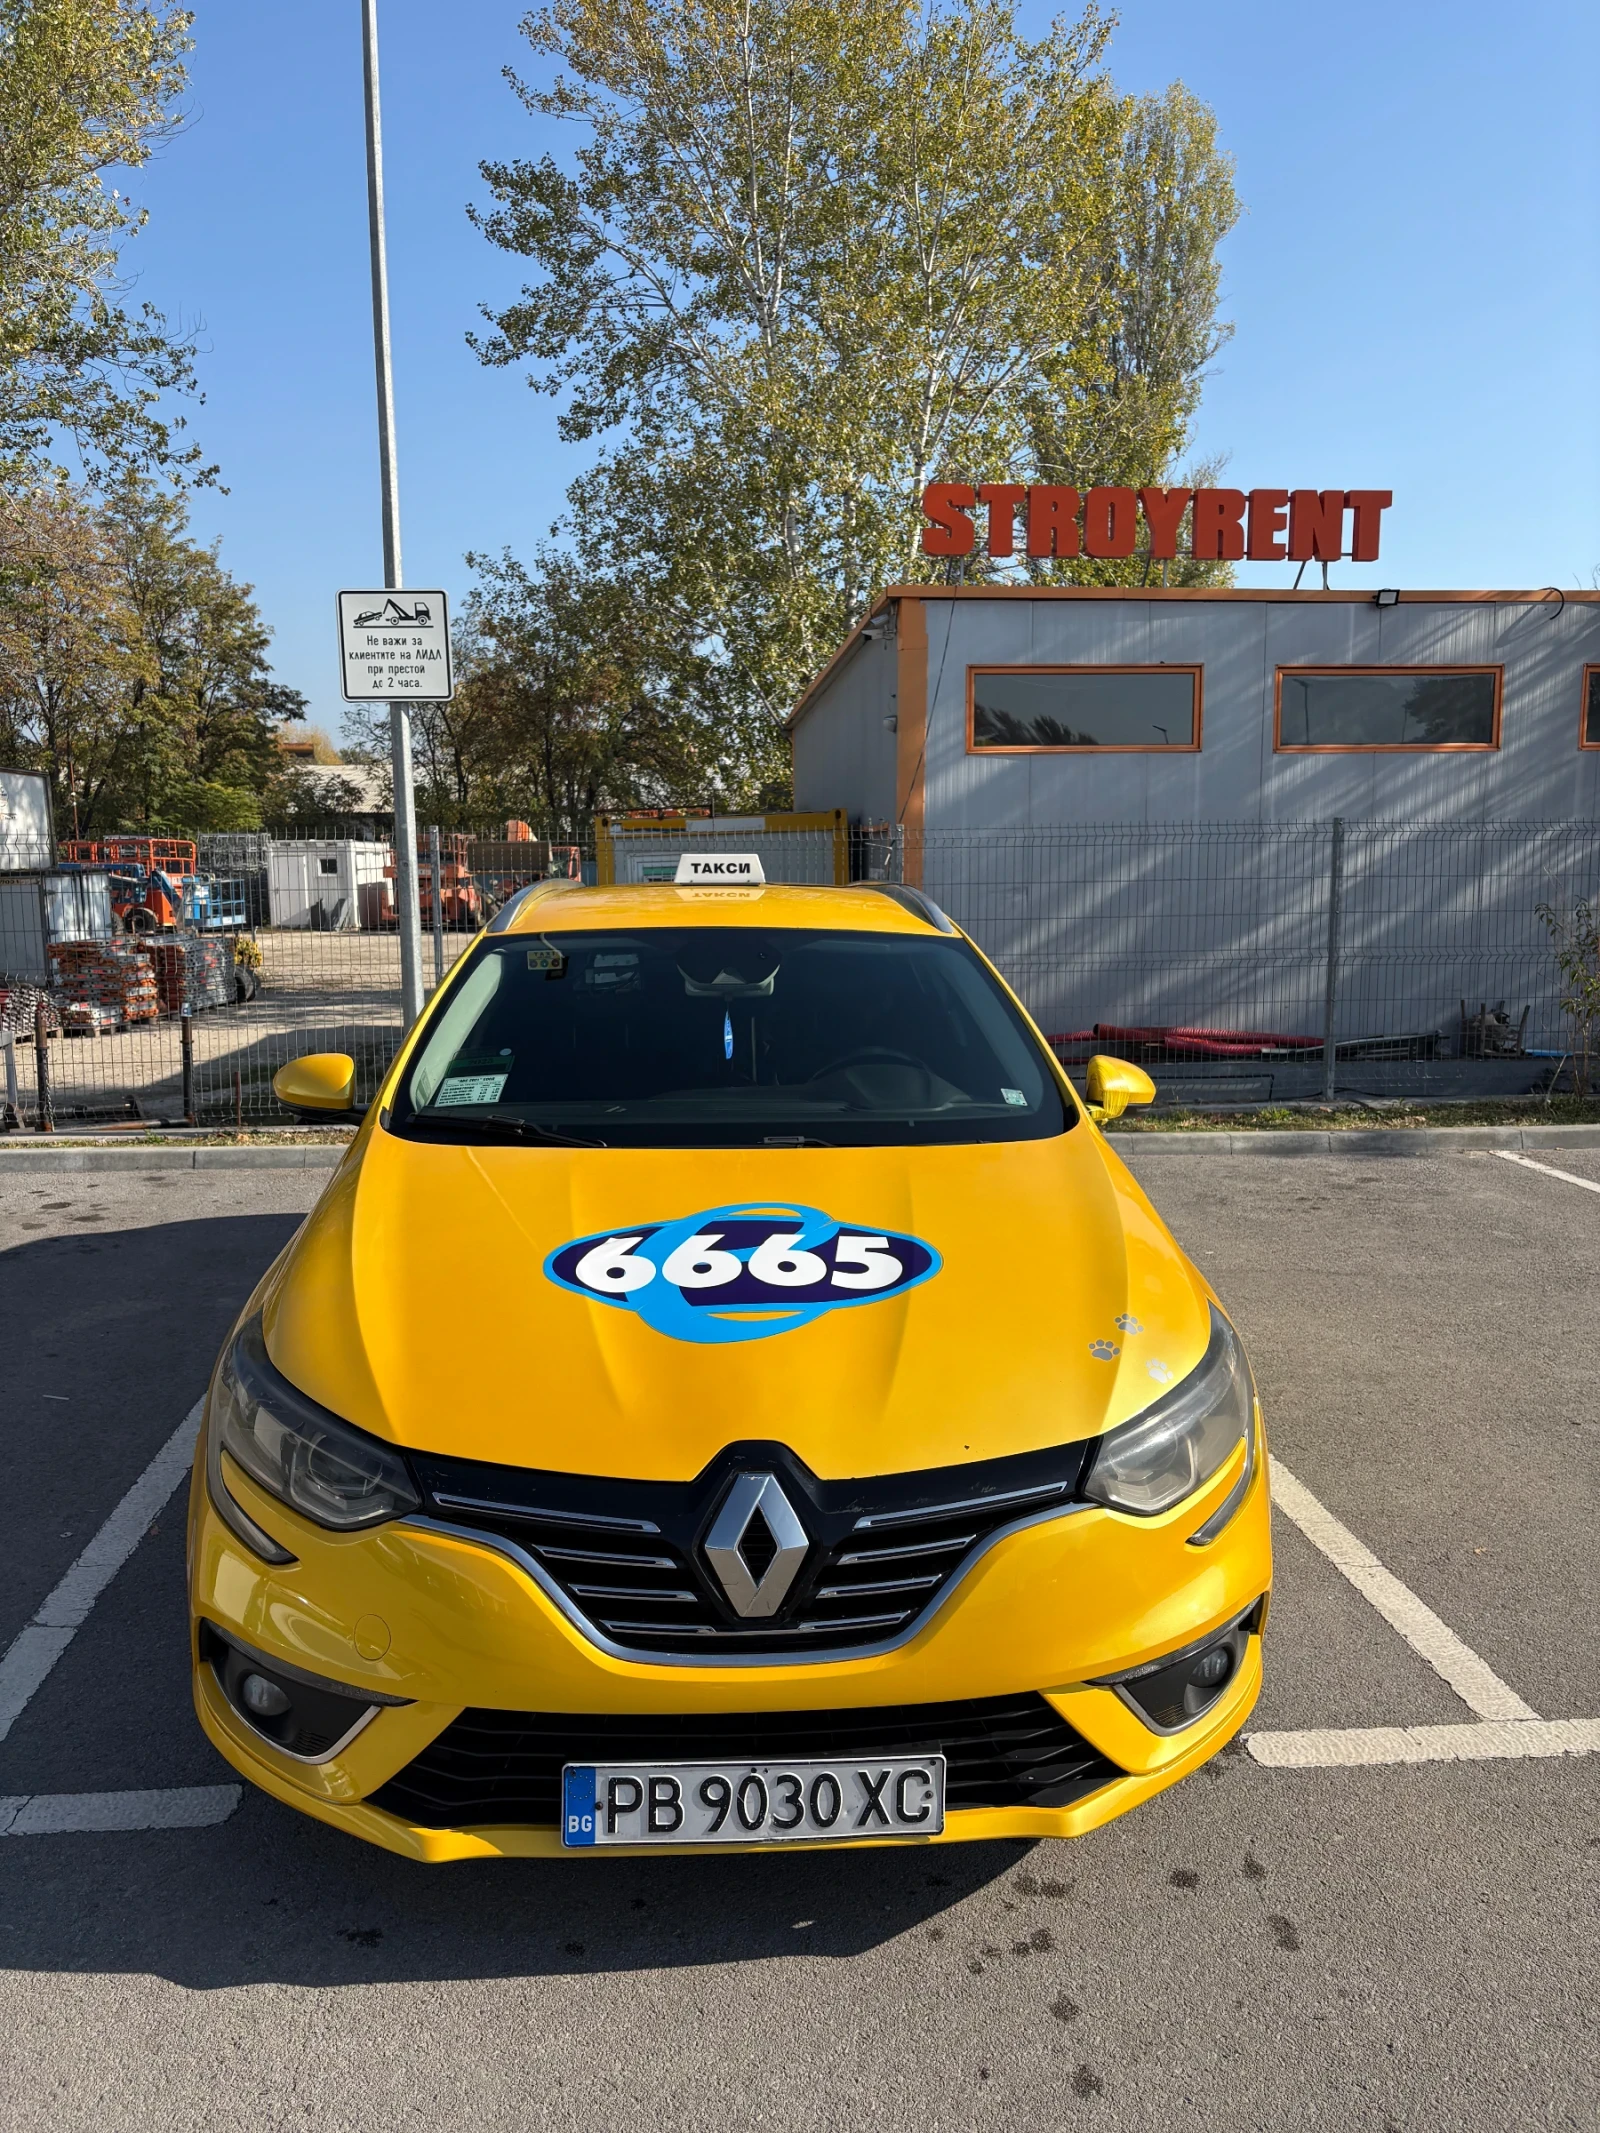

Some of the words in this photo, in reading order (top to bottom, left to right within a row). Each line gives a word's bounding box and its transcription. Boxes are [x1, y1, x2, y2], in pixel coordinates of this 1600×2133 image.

[920, 482, 1393, 562] STROYRENT
[366, 635, 379, 646] Не
[382, 637, 407, 646] важи
[411, 638, 423, 646] за
[348, 651, 396, 660] клиентите
[400, 652, 411, 660] на
[415, 649, 442, 661] ЛИДЛ
[367, 665, 384, 677] при
[388, 664, 425, 677] престой
[387, 677, 395, 688] 2
[397, 680, 423, 688] часа.
[690, 863, 751, 874] ТАКСИ
[575, 1233, 904, 1293] 6665
[699, 1771, 842, 1833] 9030
[567, 1814, 593, 1834] BG
